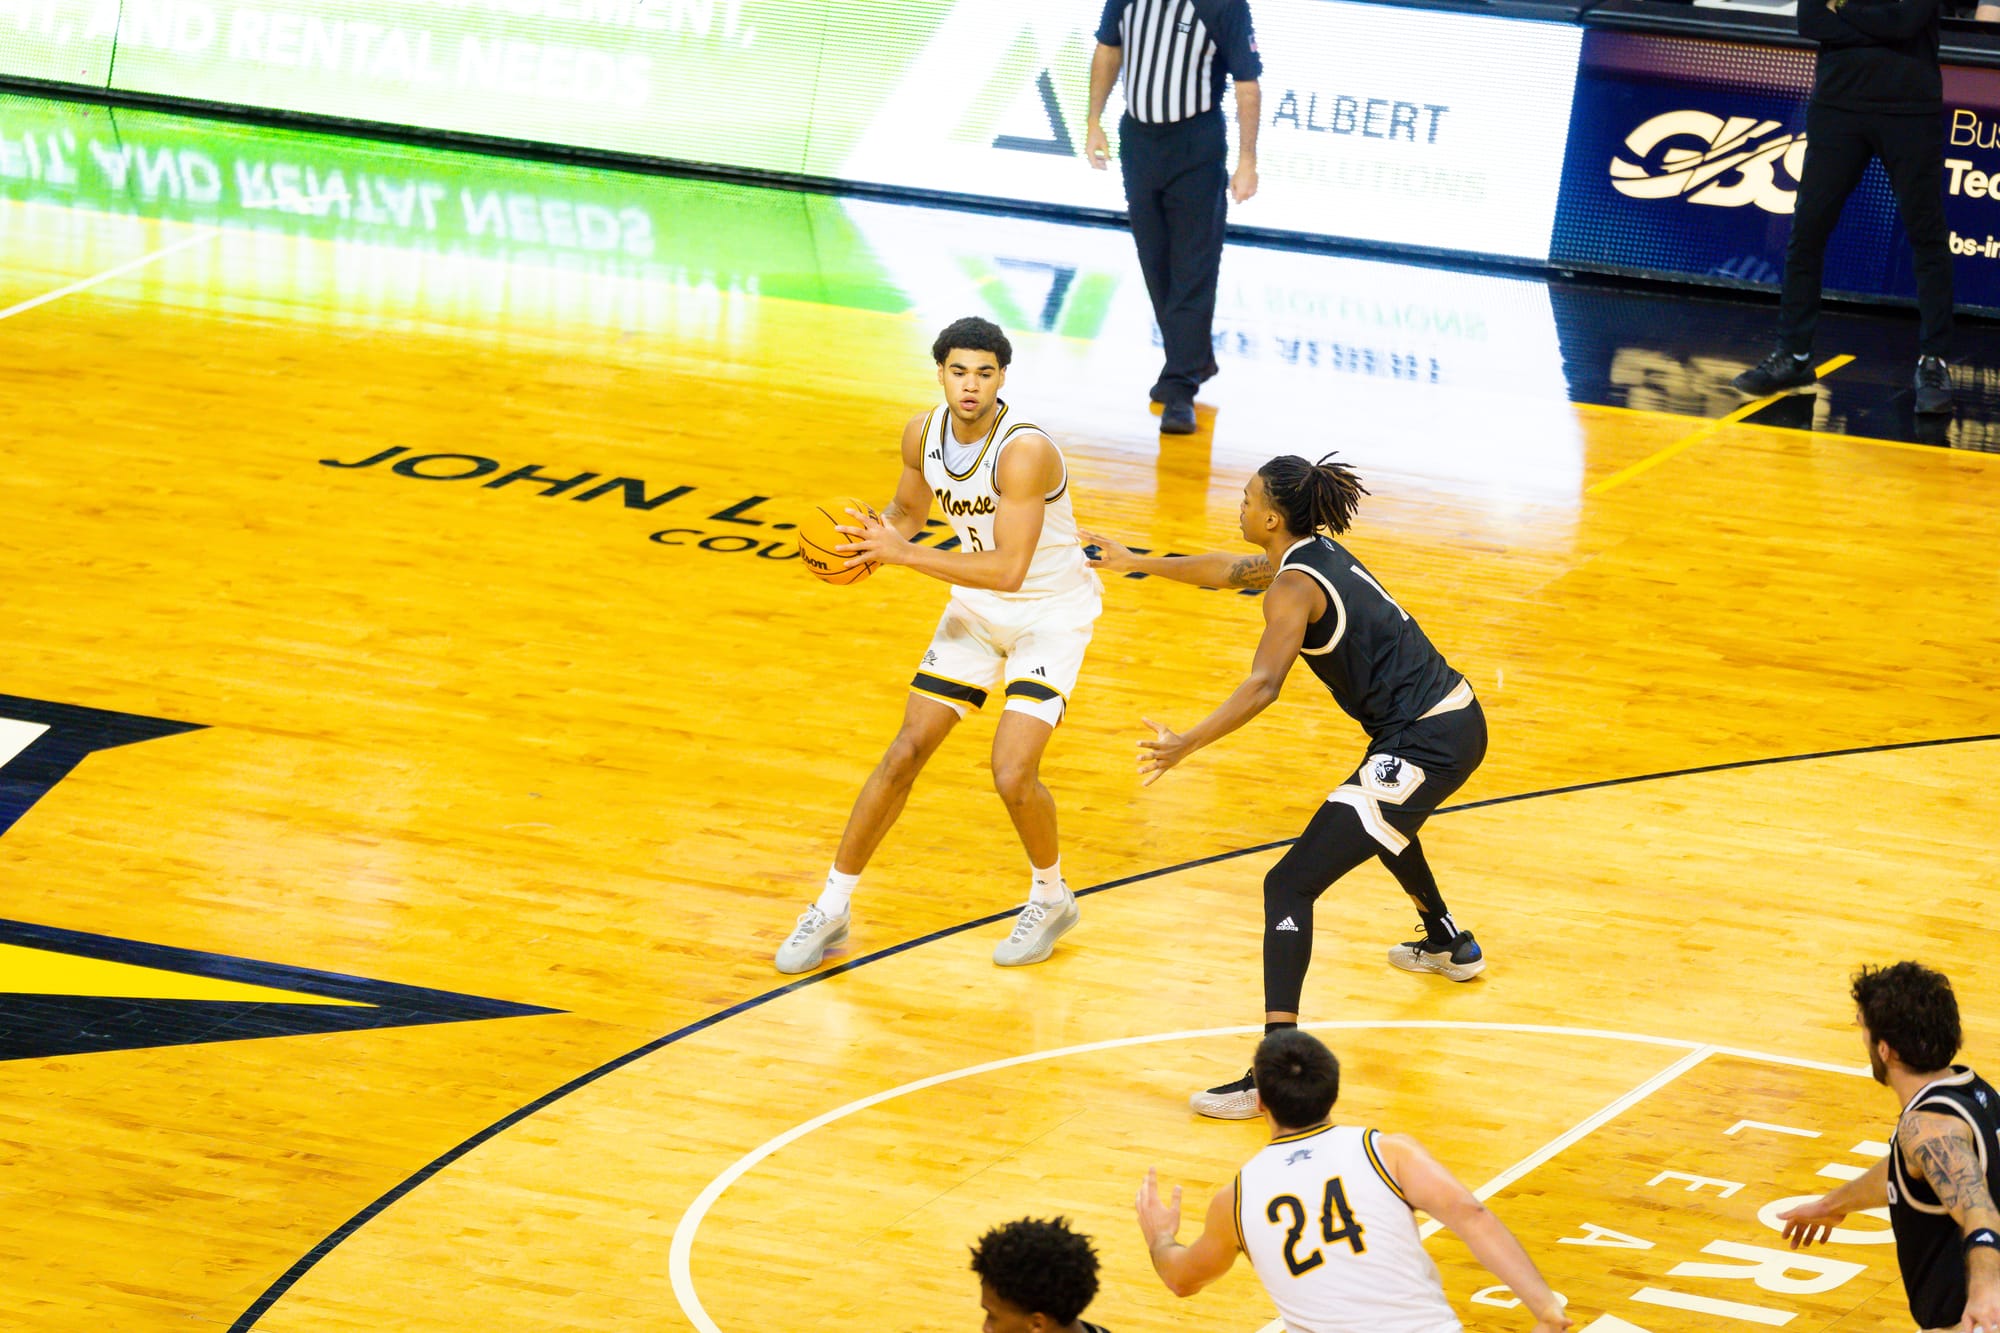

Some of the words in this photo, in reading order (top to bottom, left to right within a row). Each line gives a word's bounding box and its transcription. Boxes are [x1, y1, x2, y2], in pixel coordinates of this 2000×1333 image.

[80, 0, 216, 51] AND
[229, 8, 442, 83] RENTAL
[458, 33, 655, 107] NEEDS
[1273, 88, 1450, 145] ALBERT
[1950, 108, 2000, 149] Bu
[1261, 150, 1487, 204] SOLUTIONS
[318, 446, 698, 511] JOHN
[707, 496, 797, 530] L.
[935, 489, 996, 516] Norse
[649, 529, 800, 560] COU
[1266, 1174, 1368, 1279] 24
[1578, 1140, 1896, 1333] ORI
